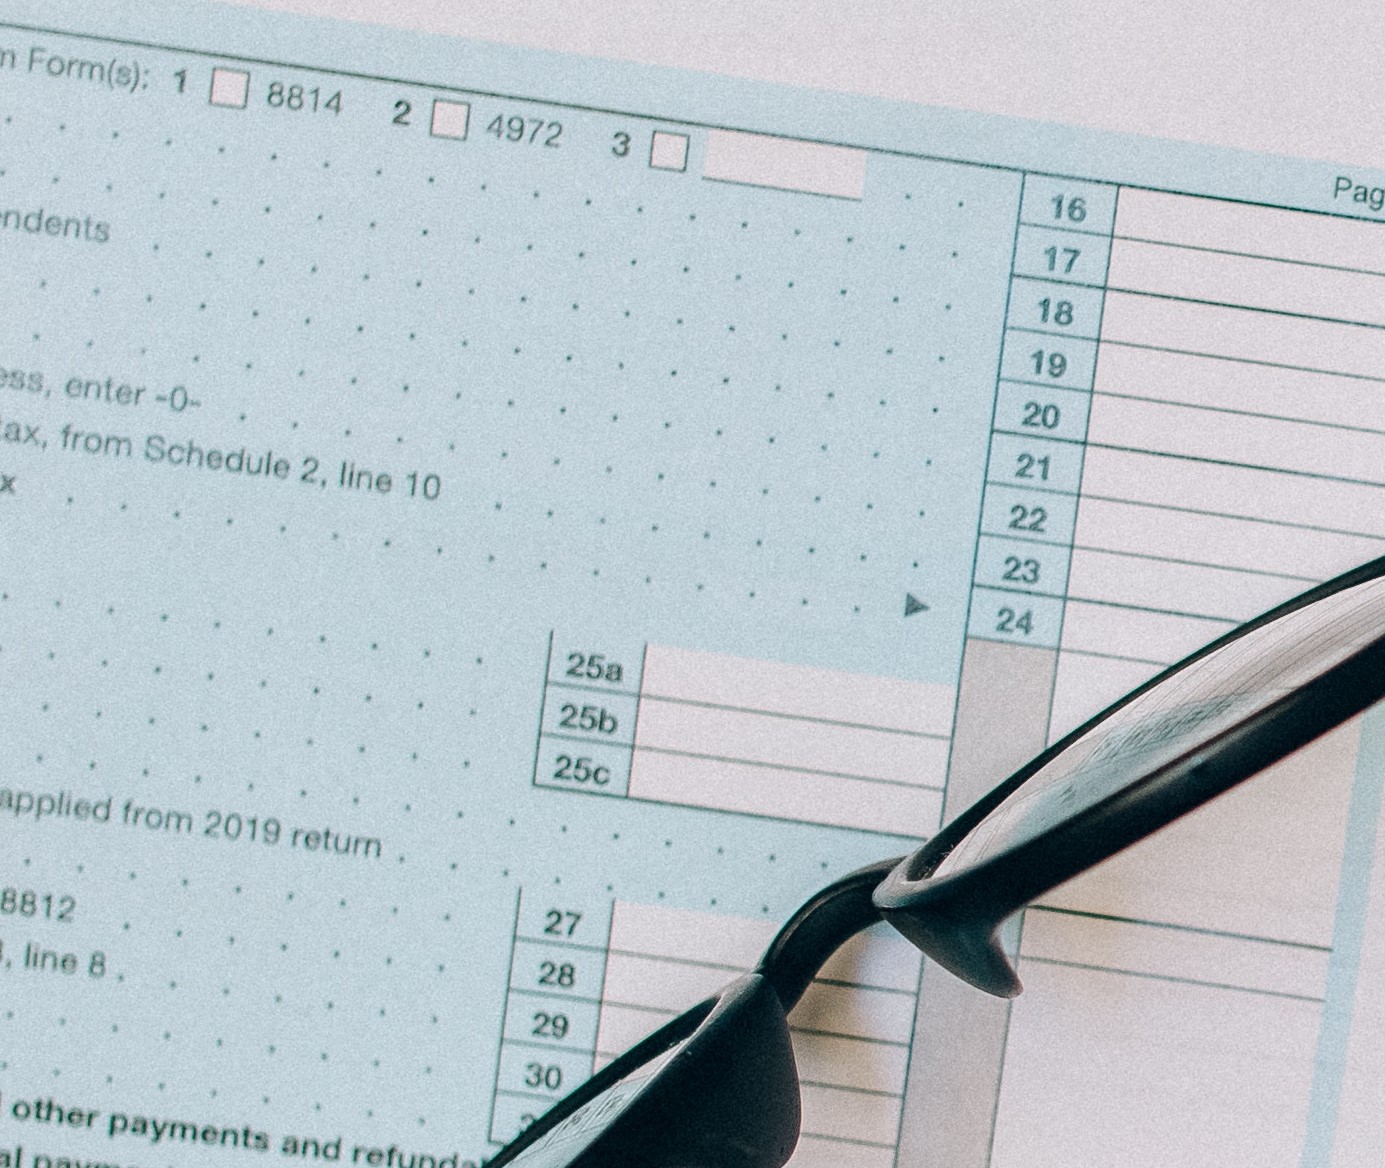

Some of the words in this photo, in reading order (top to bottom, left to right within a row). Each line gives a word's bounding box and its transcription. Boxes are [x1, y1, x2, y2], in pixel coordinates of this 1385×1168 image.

[27, 46, 150, 94] Form(s):
[173, 68, 187, 94] 1
[266, 80, 342, 115] 8814
[392, 99, 412, 127] 2
[486, 113, 564, 149] 4972
[611, 130, 632, 158] 3
[1051, 194, 1087, 223] 16
[1044, 245, 1081, 274] 17
[1038, 297, 1074, 327] 18
[1031, 349, 1068, 379] 19
[64, 377, 147, 406] enter
[154, 384, 202, 413] -0-
[1021, 401, 1061, 430] 20
[60, 423, 133, 457] from
[143, 434, 291, 480] Schedule
[299, 456, 327, 489] 2,
[338, 460, 393, 494] line
[406, 471, 442, 501] 10
[1014, 452, 1050, 482] 21
[1008, 503, 1048, 534] 22
[1001, 555, 1041, 585] 23
[995, 606, 1034, 636] 24
[565, 652, 623, 683] 25a
[559, 702, 619, 735] 25b
[553, 754, 610, 786] 25c
[0, 789, 113, 823] applied
[122, 799, 193, 833] from
[203, 810, 282, 845] 2019
[291, 827, 382, 859] return
[0, 887, 76, 923] 8812
[543, 908, 582, 937] 27
[23, 942, 78, 974] line
[87, 950, 106, 978] 8
[537, 960, 576, 989] 28
[531, 1011, 570, 1040] 29
[524, 1062, 563, 1091] 30
[11, 1098, 98, 1128] other
[107, 1113, 269, 1152] payments
[281, 1136, 342, 1161] and
[352, 1146, 490, 1168] refund
